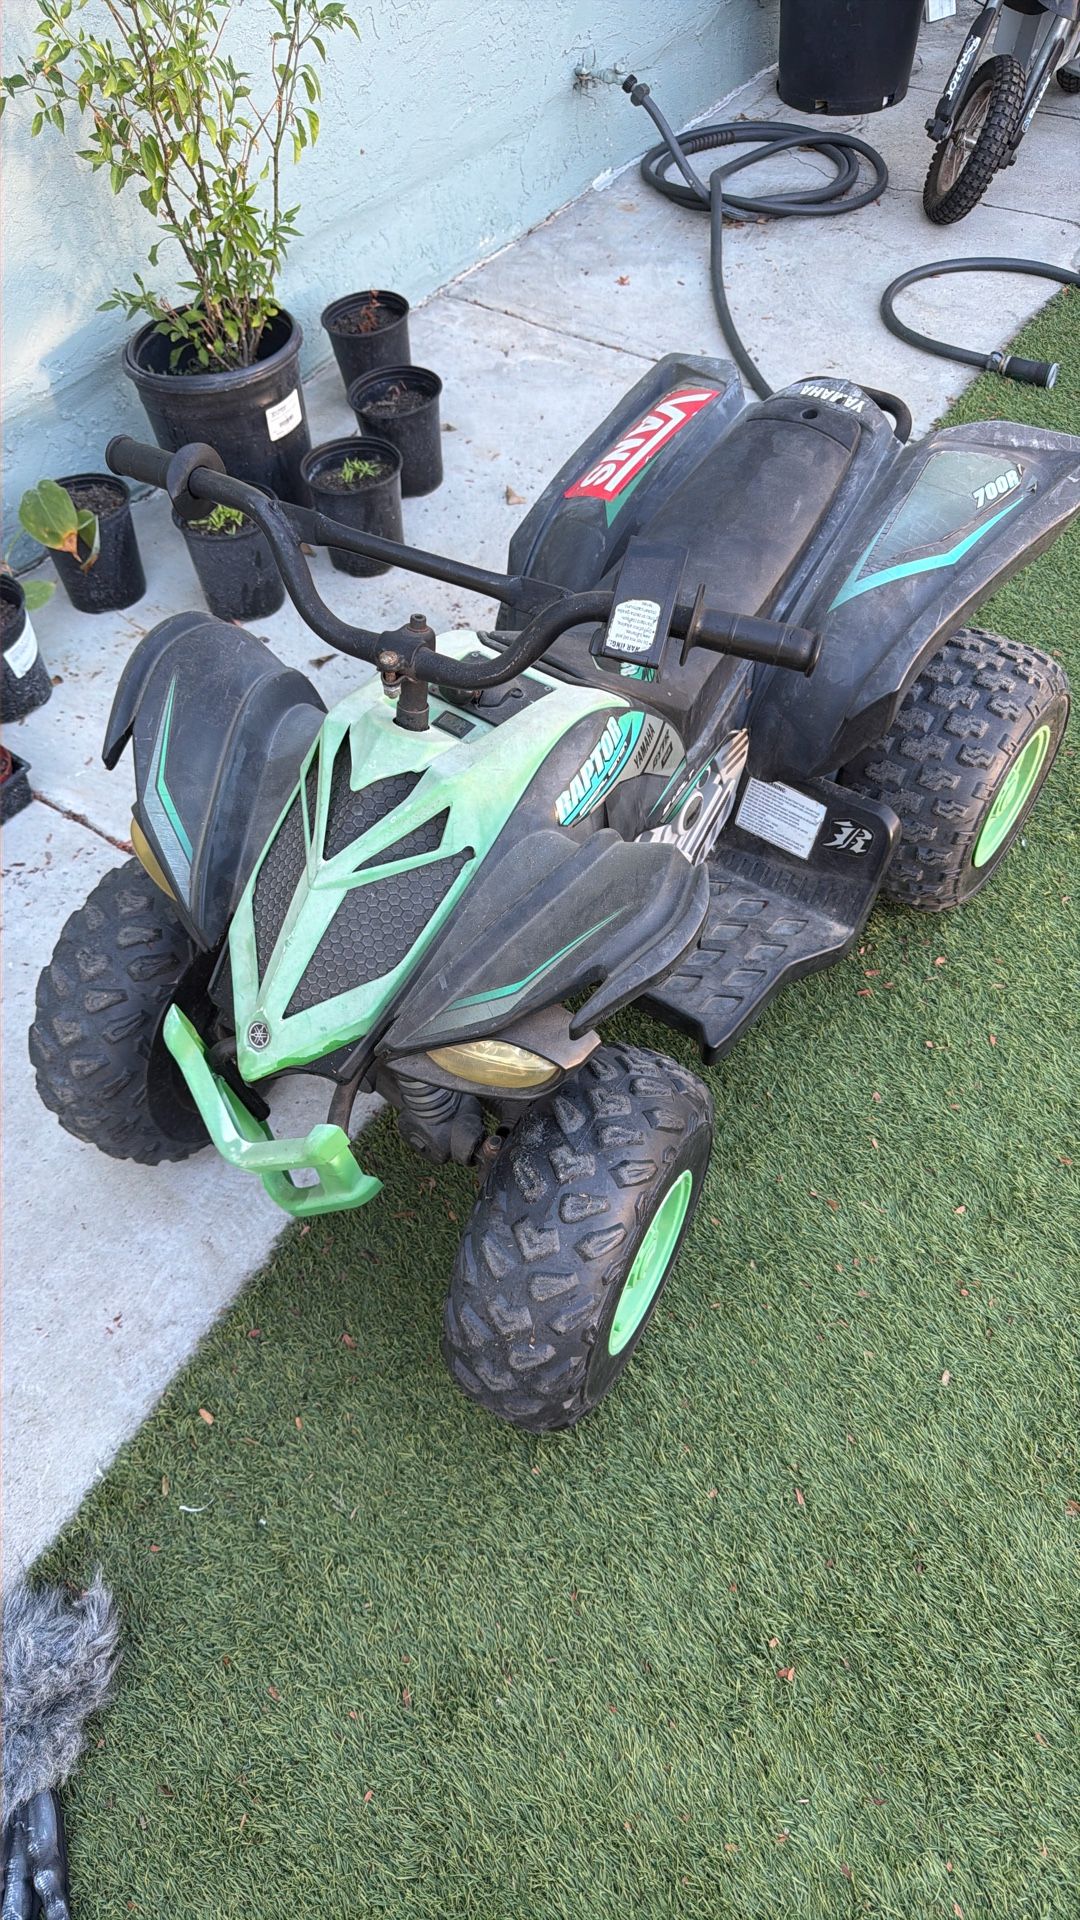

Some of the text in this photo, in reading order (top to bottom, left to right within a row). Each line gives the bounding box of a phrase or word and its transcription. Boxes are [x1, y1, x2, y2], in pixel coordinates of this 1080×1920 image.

[946, 45, 976, 100] Razor
[580, 393, 712, 492] VANS
[972, 469, 1020, 509] 700R
[555, 716, 623, 822] RAPTOR
[633, 723, 655, 769] YAMAHA
